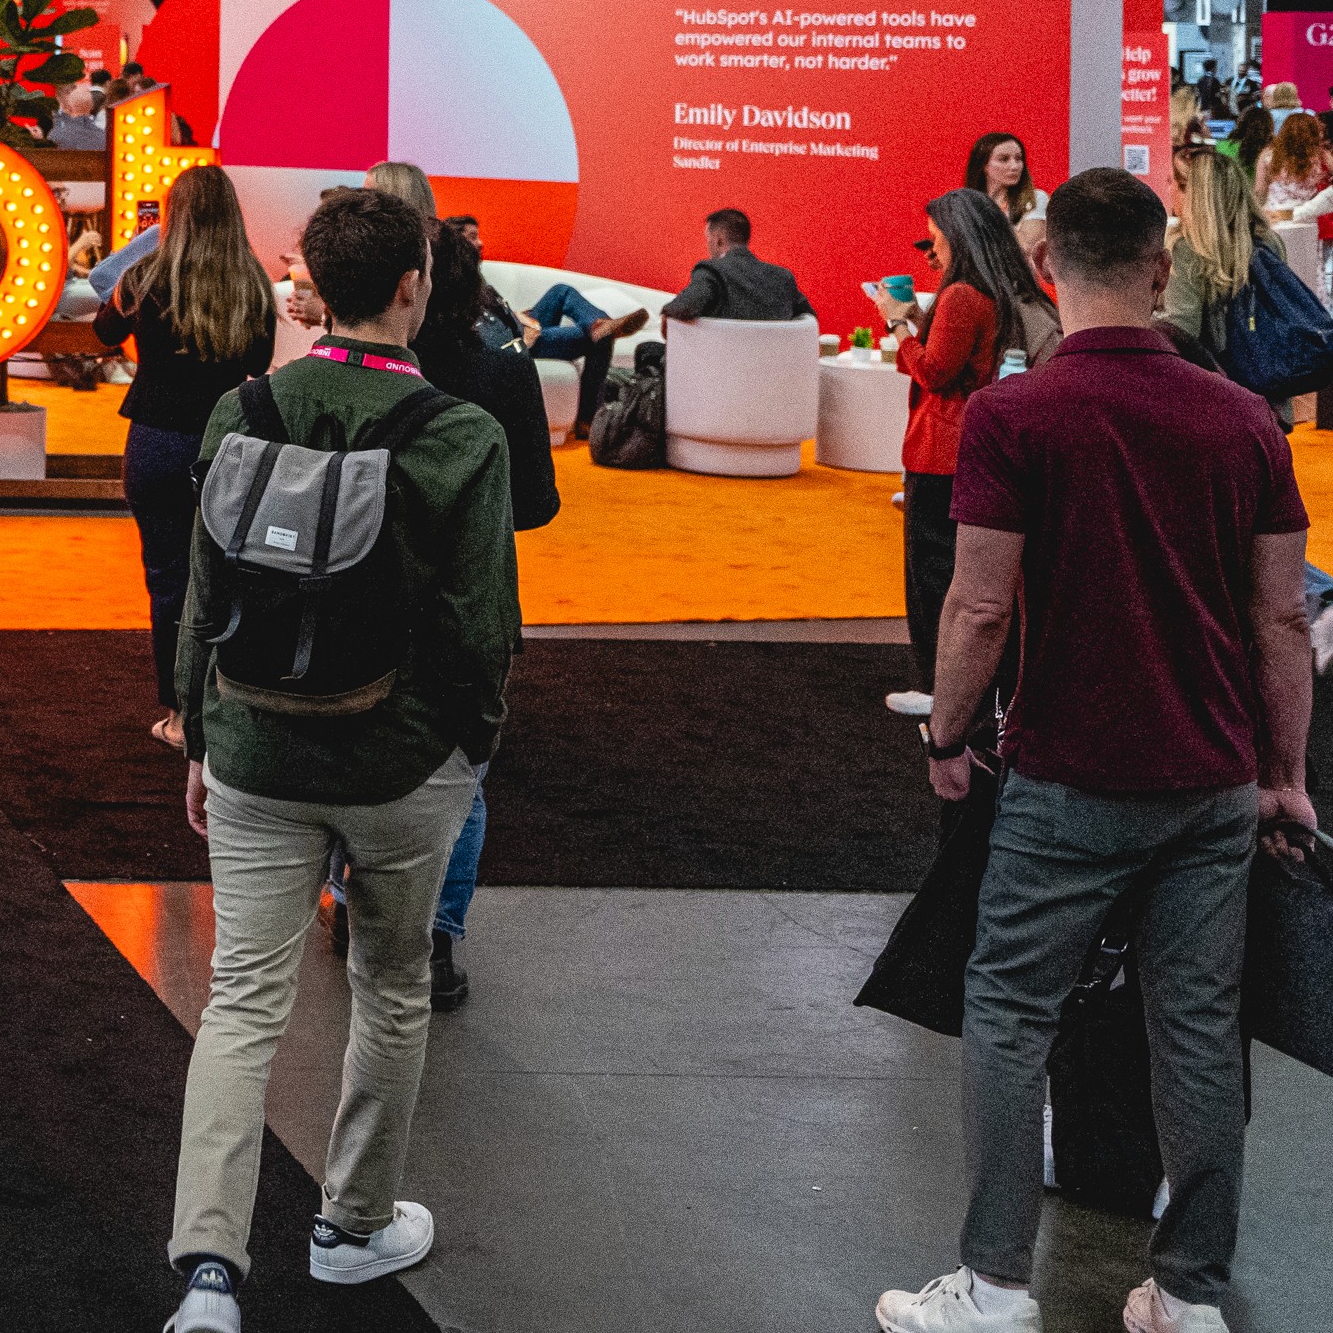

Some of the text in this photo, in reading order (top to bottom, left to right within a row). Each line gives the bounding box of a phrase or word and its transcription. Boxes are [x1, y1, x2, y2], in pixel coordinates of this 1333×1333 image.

[772, 10, 876, 28] AI-powered
[882, 11, 926, 26] tools
[931, 11, 976, 27] have
[675, 31, 966, 50] empowered our internal teams to
[675, 52, 715, 66] work
[719, 54, 790, 70] smarter,
[795, 54, 824, 68] not
[1127, 68, 1161, 85] grow
[674, 103, 851, 130] Emily Davidson
[673, 137, 879, 160] Director of Enterprise Marketing
[673, 155, 721, 170] Sandler
